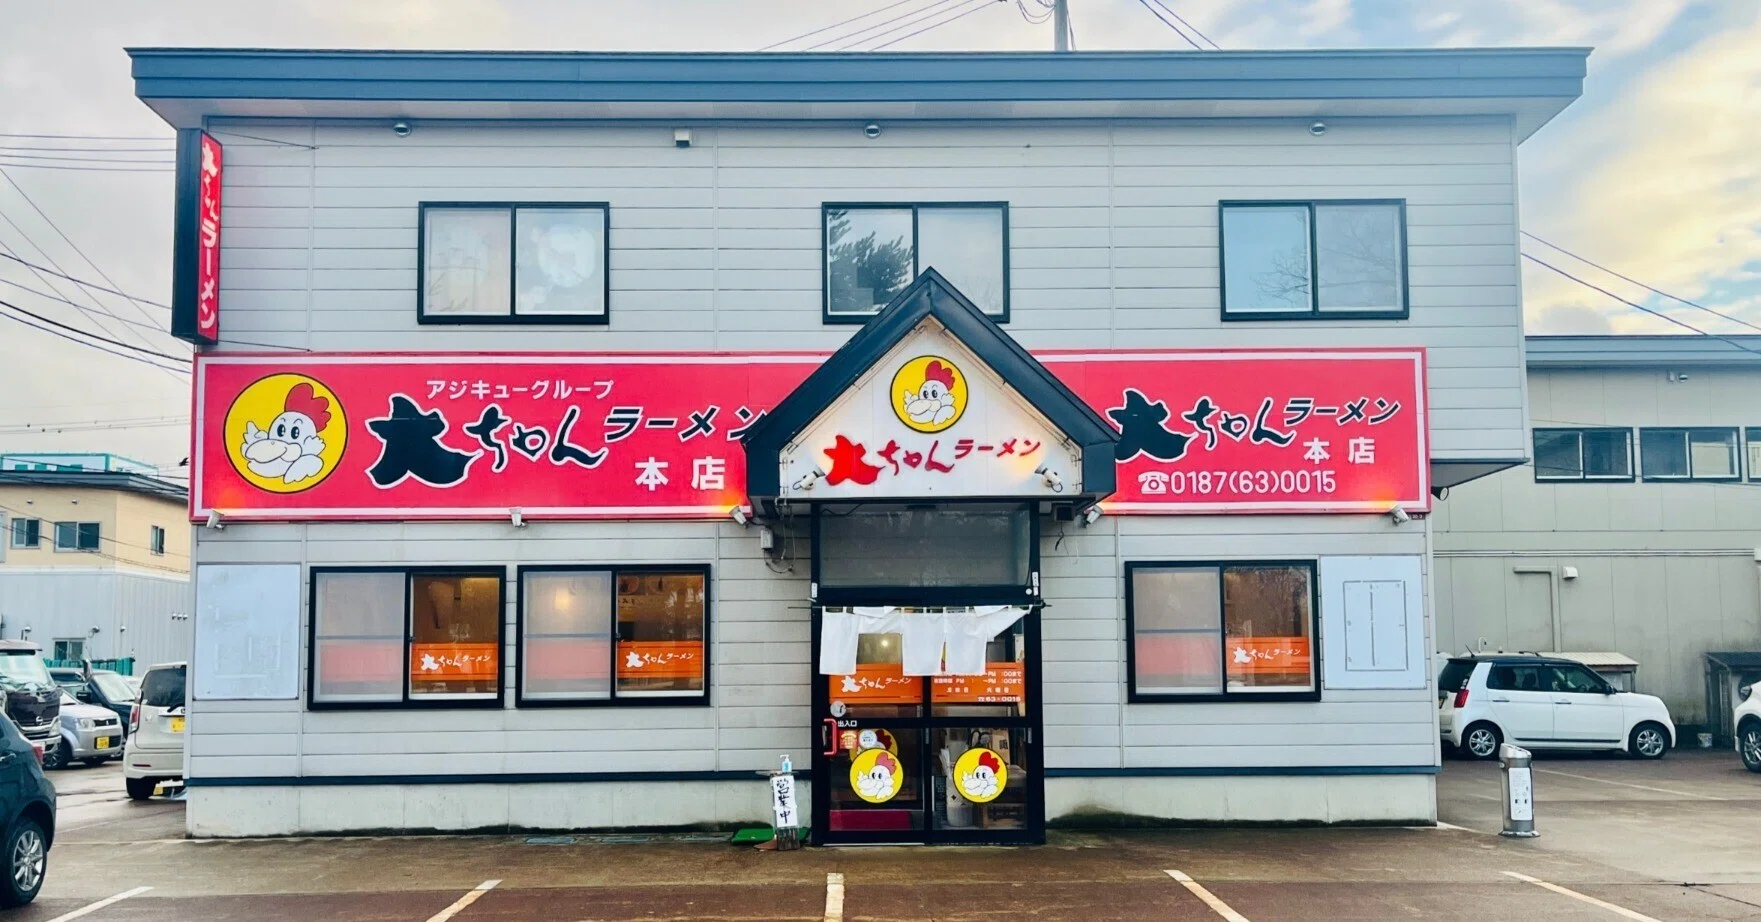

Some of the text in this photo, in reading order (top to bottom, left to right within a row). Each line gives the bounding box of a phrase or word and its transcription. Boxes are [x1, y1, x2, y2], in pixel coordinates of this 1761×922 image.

[426, 379, 614, 400] アジキューグループ
[1303, 437, 1375, 464] 本店
[634, 456, 725, 491] 本店
[1170, 470, 1336, 494] 0187(63)0015
